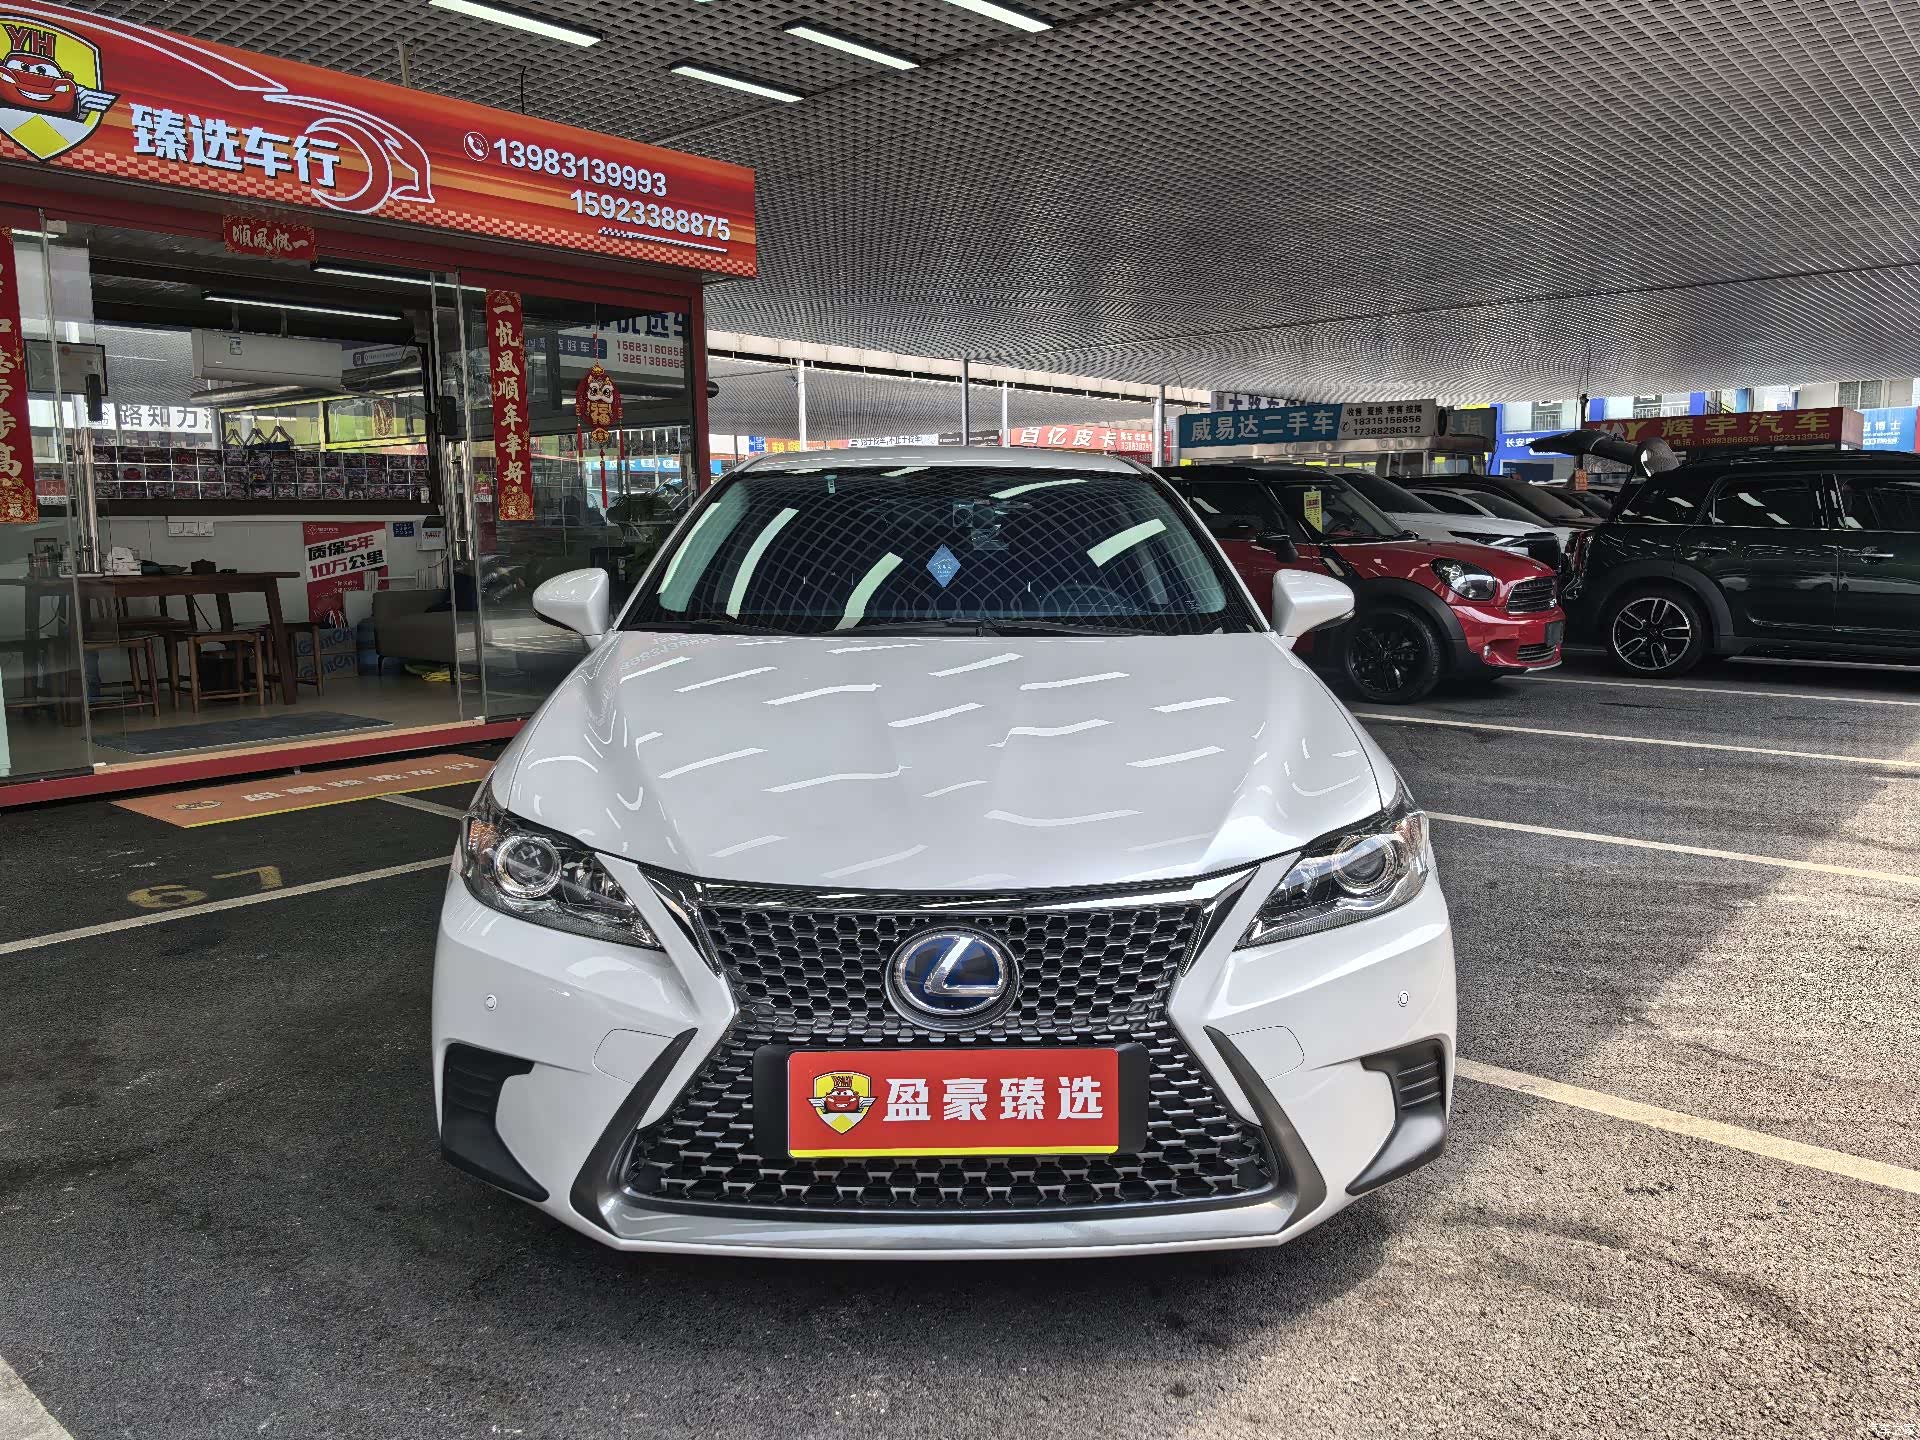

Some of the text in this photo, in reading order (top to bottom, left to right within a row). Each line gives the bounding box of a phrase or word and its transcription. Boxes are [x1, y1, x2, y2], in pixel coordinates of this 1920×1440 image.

[4, 24, 57, 58] YH
[130, 103, 340, 187] 臻选车行
[493, 137, 667, 197] 13983139993
[570, 188, 731, 241] 15923388875
[1020, 426, 1118, 448] 百亿皮卡
[1191, 410, 1334, 442] 威易达二手车
[1352, 425, 1421, 436] 17388286312
[1661, 411, 1830, 438] 辉宇汽车
[308, 534, 375, 562] 质保5年
[309, 549, 385, 579] 10万公里
[882, 1075, 1104, 1122] 盈豪臻选
